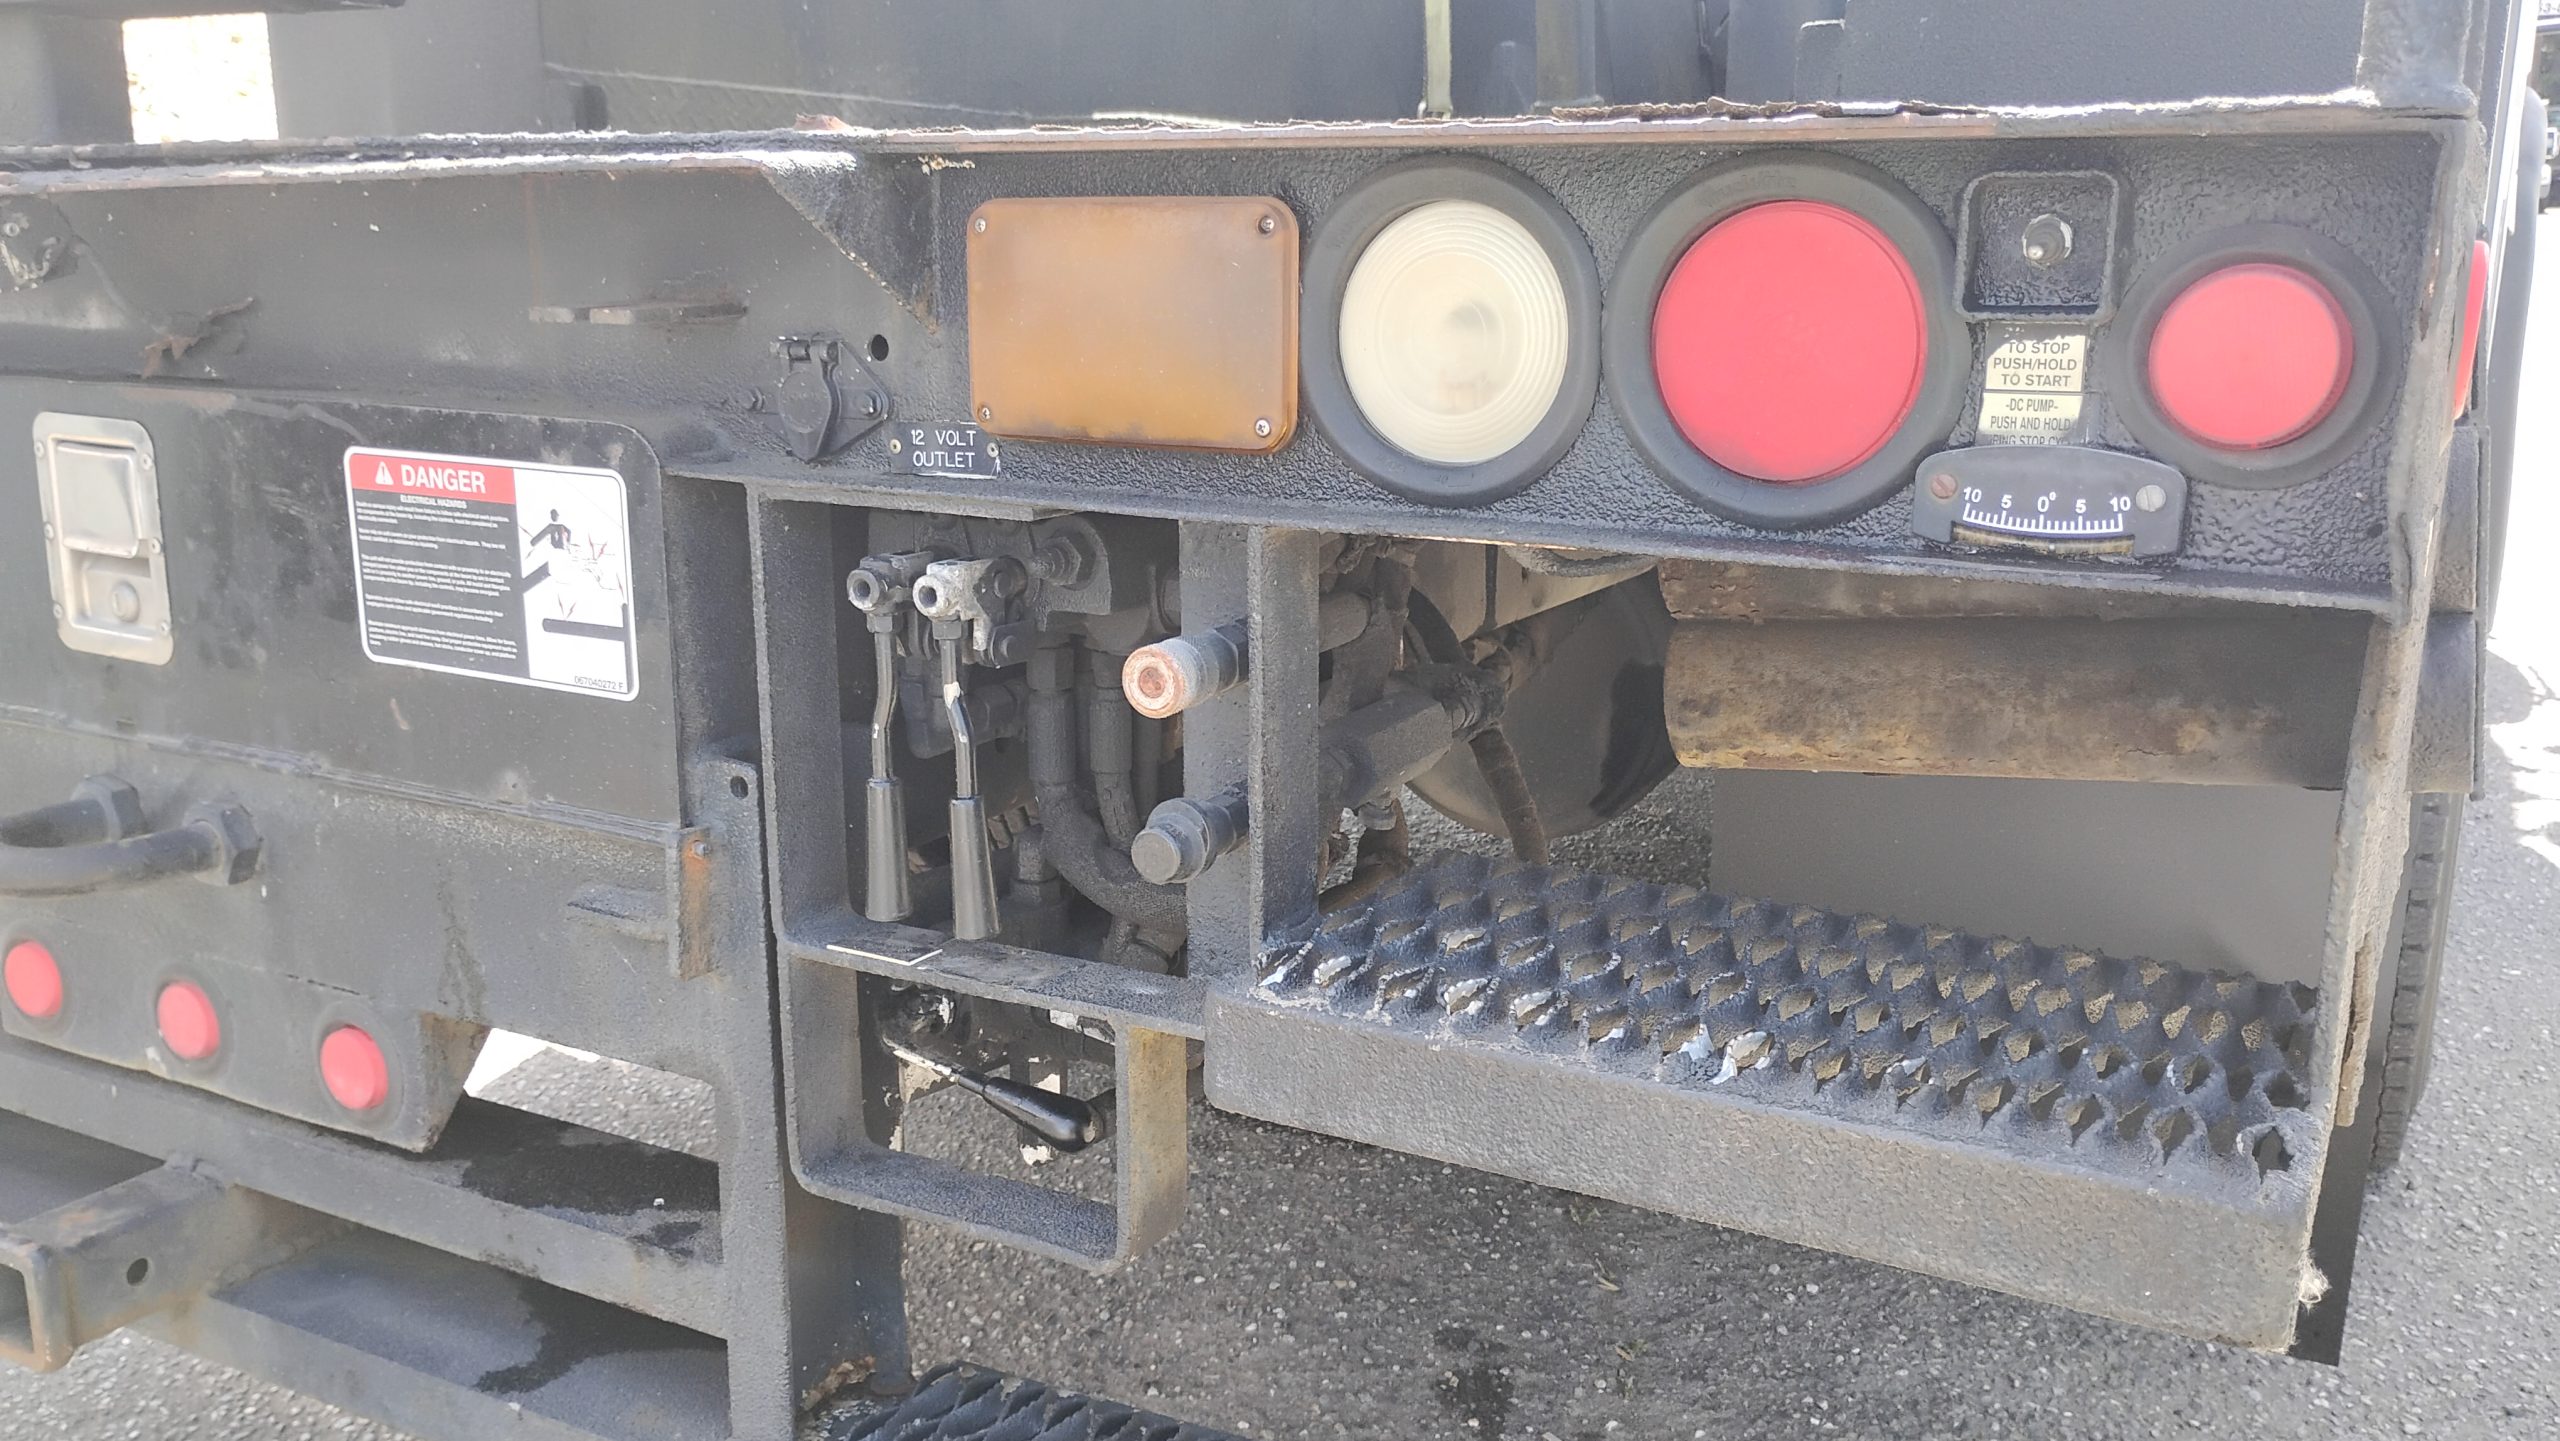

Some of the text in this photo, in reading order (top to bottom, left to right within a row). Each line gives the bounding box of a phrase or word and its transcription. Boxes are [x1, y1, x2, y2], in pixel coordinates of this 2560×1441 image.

[2009, 342, 2071, 355] TO STOP
[1993, 357, 2077, 371] PUSH/HOLD
[2001, 373, 2072, 387] TO START
[2005, 398, 2059, 412] -DC PUMP-
[1990, 415, 2072, 431] PUSH AND HOLD
[911, 429, 977, 446] 12 VOLT
[913, 451, 976, 468] OUTLET
[400, 464, 486, 494] DANGER
[1963, 486, 1982, 503] 10
[2001, 494, 2013, 509] 5
[2075, 498, 2088, 513] 5
[2109, 496, 2132, 512] 10
